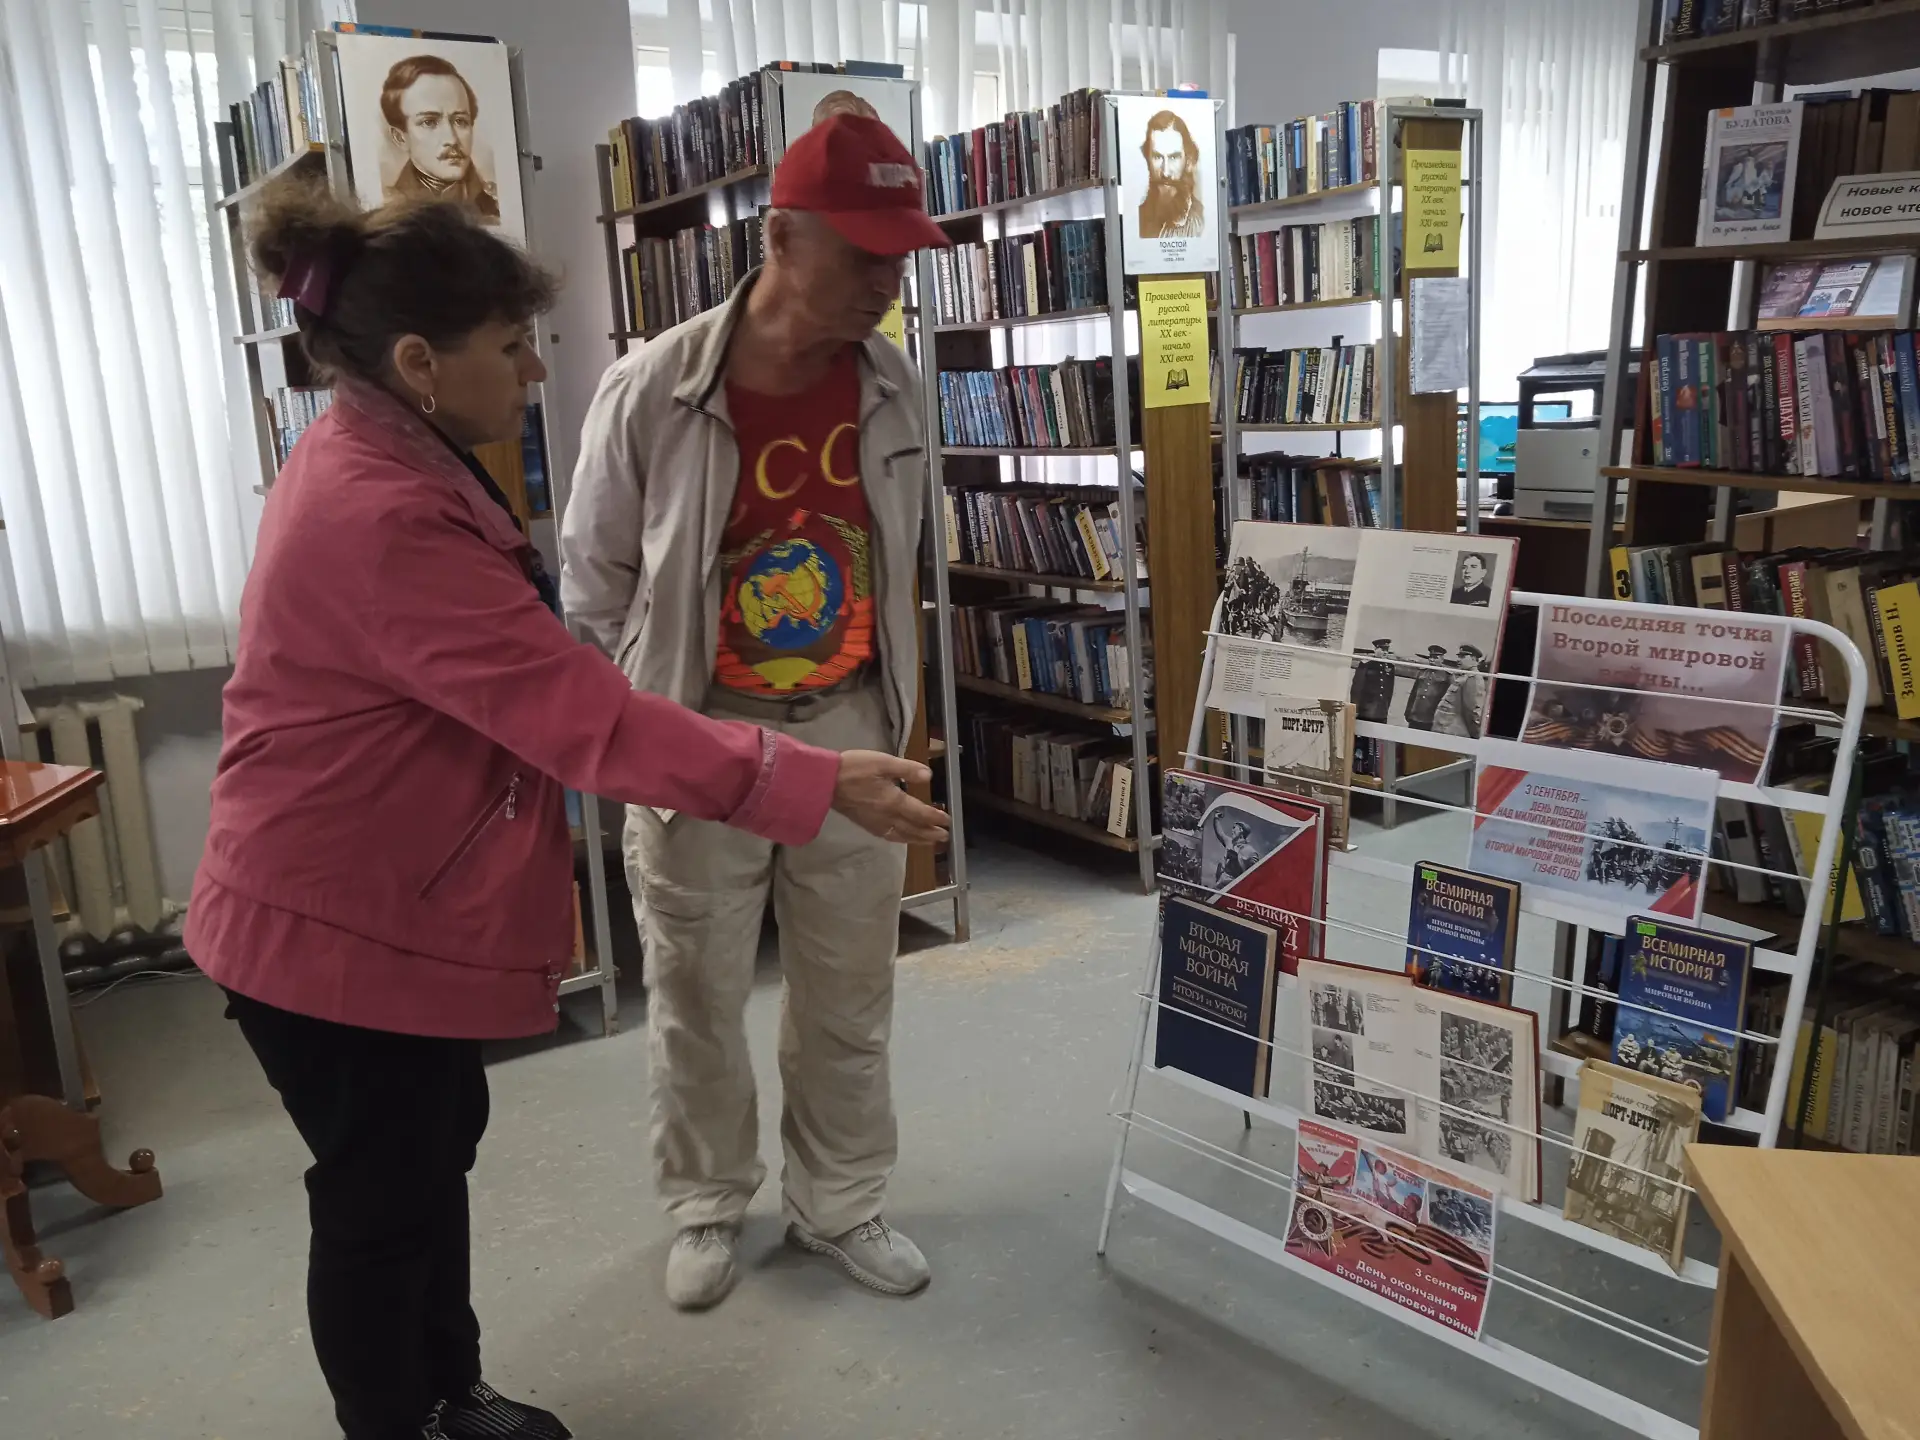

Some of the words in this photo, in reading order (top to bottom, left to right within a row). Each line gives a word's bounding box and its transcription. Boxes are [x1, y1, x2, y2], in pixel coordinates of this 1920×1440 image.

[1725, 115, 1791, 130] БУЛАТОВА
[1847, 186, 1905, 197] Новые
[1840, 205, 1893, 217] новое
[1160, 240, 1187, 248] ТОЛСТОЙ
[1145, 291, 1201, 303] Произведения
[1158, 304, 1190, 315] русской
[1148, 317, 1202, 327] литературы
[1162, 342, 1191, 351] начало
[1175, 354, 1194, 363] века
[1779, 396, 1794, 438] ШАХТА
[1727, 563, 1741, 613] ВПРАКСИЯ
[1885, 602, 1900, 621] Н.
[1551, 606, 1686, 635] Последняя
[1696, 621, 1773, 643] точка
[1552, 632, 1640, 659] Второй
[1649, 646, 1766, 671] мировой
[1892, 624, 1915, 700] Задорнов
[1282, 717, 1324, 733] ПОРТ-АРТУР
[1525, 784, 1532, 795] 3
[1532, 785, 1581, 803] СЕНТЯБРЯ
[1496, 807, 1515, 819] НАД
[1515, 810, 1588, 832] МИЛИТАРИСТСКОЙ
[1529, 801, 1552, 814] ДЕНЬ
[1553, 805, 1588, 821] ПОБЕДЫ
[1485, 839, 1514, 853] ВТОРОЙ
[1515, 846, 1551, 861] МИРОВОЙ
[1552, 852, 1583, 868] ВОЙНЫ
[1528, 837, 1535, 846] И
[1536, 838, 1585, 856] ОКОНЧАНИЯ
[1426, 879, 1494, 908] ВСЕМИРНАЯ
[1236, 899, 1299, 929] ВЕЛИКИХ
[1432, 894, 1485, 920] ИСТОРИЯ
[1189, 921, 1241, 954] ВТОРАЯ
[1426, 924, 1459, 938] МИРОВОЙ
[1459, 933, 1485, 946] ВОЙНЫ
[1431, 919, 1453, 930] ИТОГИ
[1454, 923, 1481, 938] ВТОРОЙ
[1179, 936, 1249, 976] МИРОВАЯ
[1643, 935, 1726, 968] ВСЕМИРНАЯ
[1186, 957, 1238, 991] ВОЙНА
[1650, 953, 1714, 981] ИСТОРИЯ
[1172, 983, 1204, 1003] ИТОГИ
[1214, 999, 1247, 1021] УРОКИ
[1644, 987, 1682, 1003] МИРОВАЯ
[1683, 995, 1712, 1011] ВОЙНА
[1663, 984, 1694, 997] ВТОРАЯ
[1601, 1100, 1661, 1134] ПОРТ-АРТУР
[1356, 1259, 1387, 1280] День
[1390, 1277, 1458, 1312] окончания
[1415, 1268, 1422, 1277] 3
[1425, 1273, 1478, 1303] сентября
[1336, 1264, 1378, 1290] Второй
[1381, 1284, 1436, 1317] Мировой
[1438, 1313, 1478, 1338] войны
